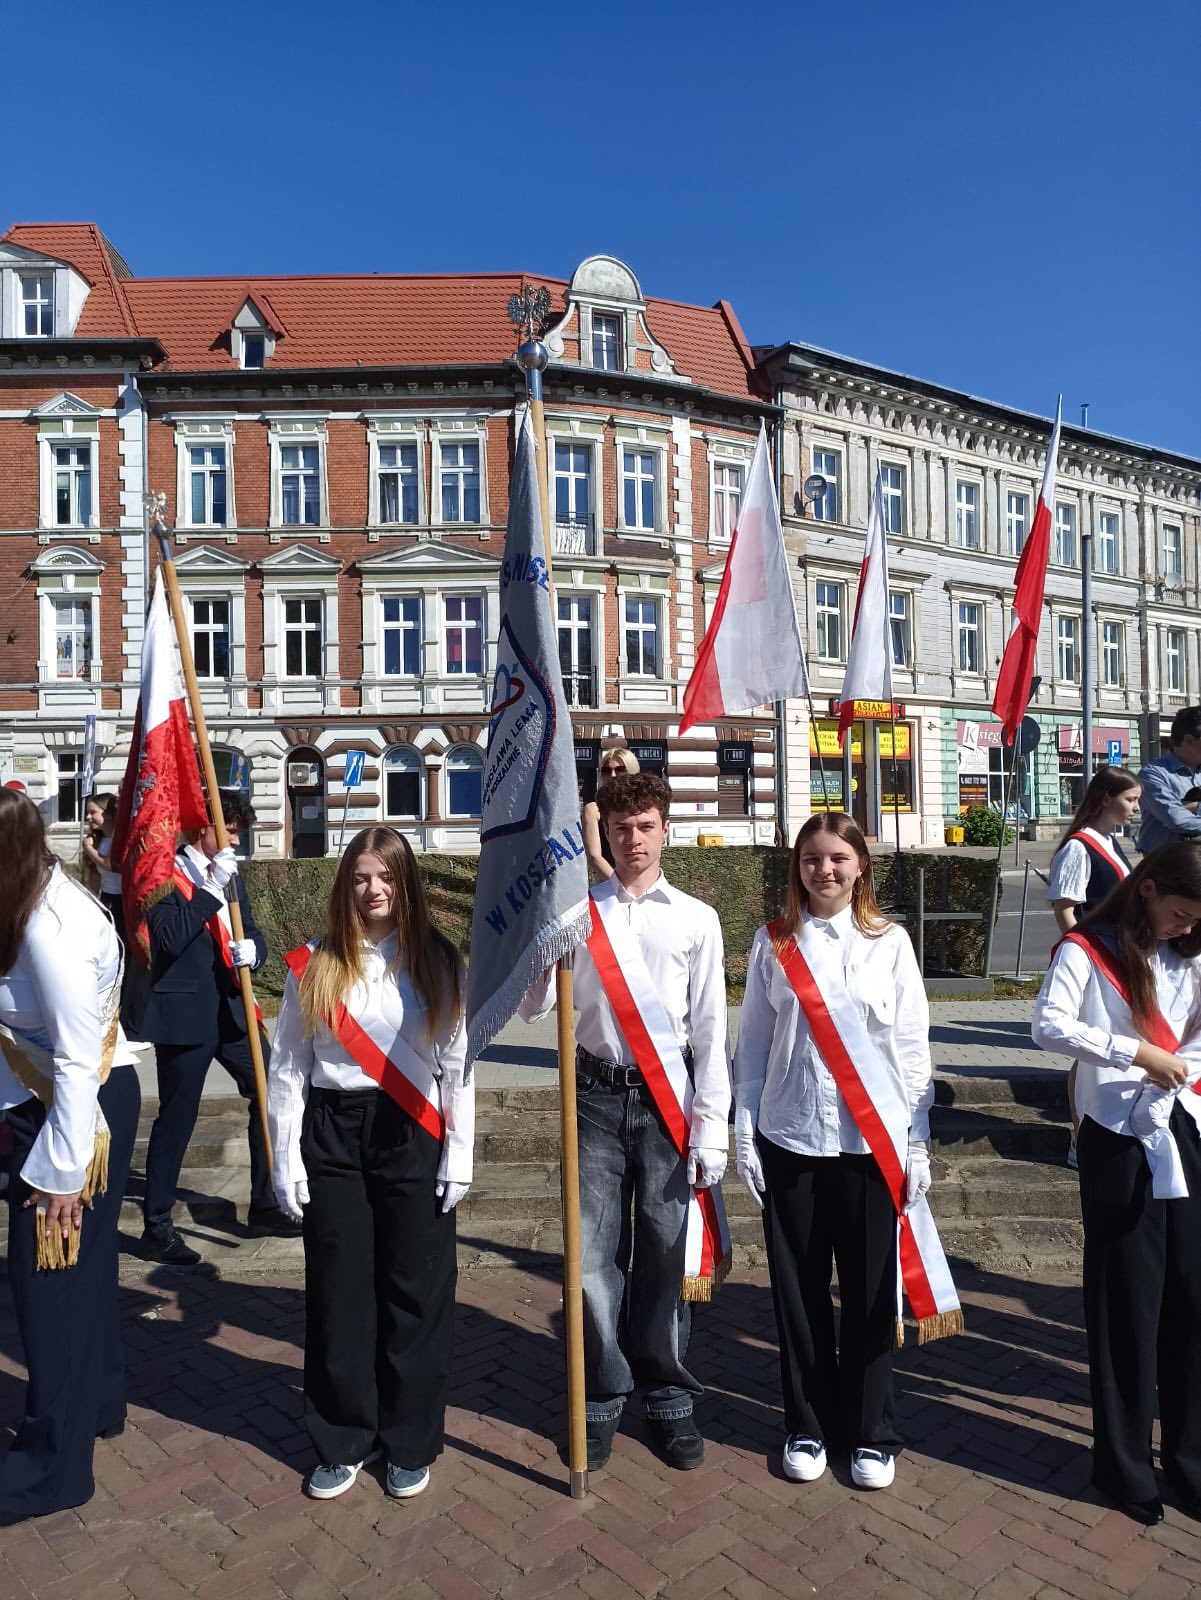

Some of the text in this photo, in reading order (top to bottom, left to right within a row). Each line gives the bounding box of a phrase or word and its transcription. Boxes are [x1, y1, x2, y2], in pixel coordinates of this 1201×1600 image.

[856, 702, 883, 712] ASIAN
[1111, 741, 1120, 757] P
[485, 903, 508, 936] W
